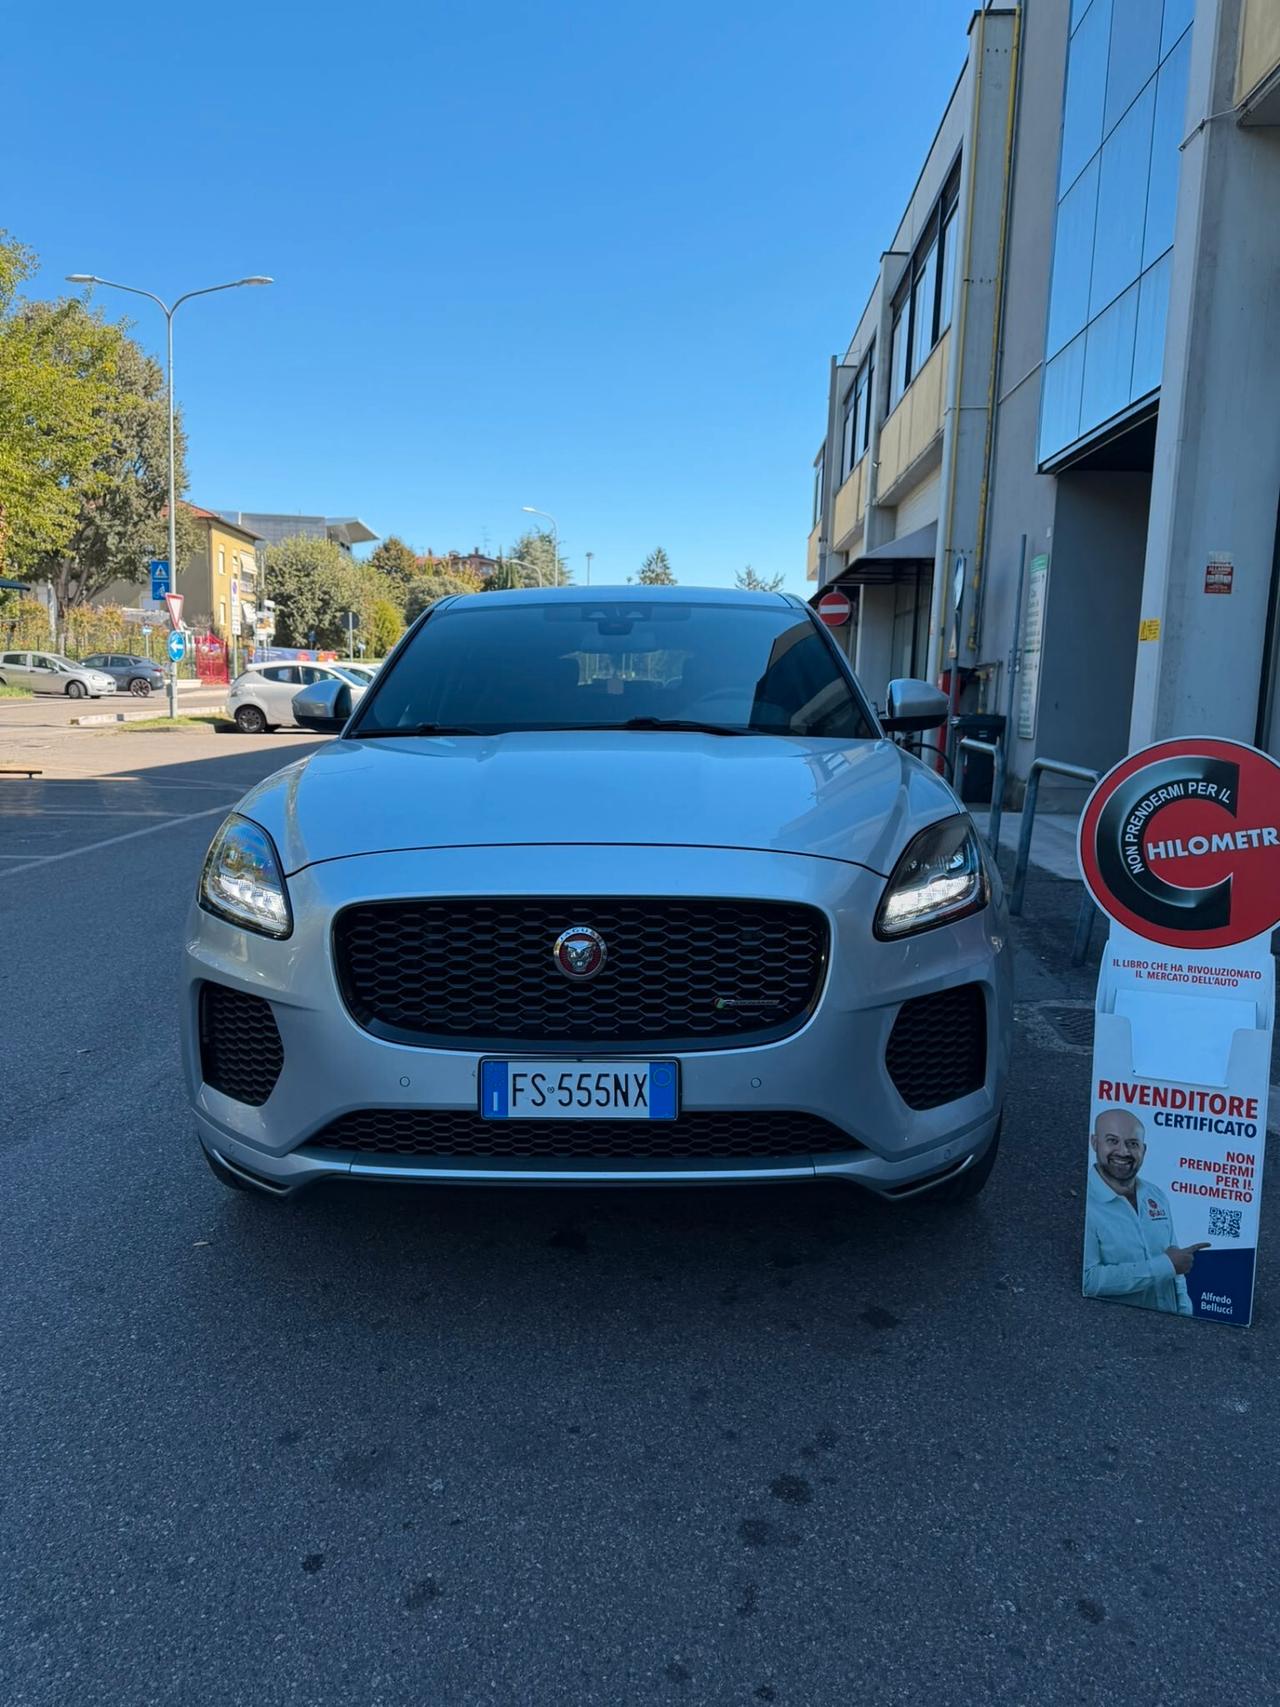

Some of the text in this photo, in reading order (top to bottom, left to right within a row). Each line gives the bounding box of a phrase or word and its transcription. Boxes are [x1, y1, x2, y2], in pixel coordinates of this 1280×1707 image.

[1125, 781, 1231, 875] NON PRENDERMI PER IL
[1112, 959, 1262, 980] IL LIBRO CHE HA RIVOLUZIONATO
[1135, 970, 1239, 987] IL MERCATO DELL'AUTO
[1098, 1080, 1259, 1120] RIVENDITORE
[1153, 1111, 1257, 1138] CERTIFICATO
[1179, 1157, 1254, 1178] PRENDERMI
[1226, 1151, 1255, 1166] NON
[1170, 1180, 1253, 1203] CHILOMETRO
[1215, 1174, 1239, 1189] PER
[1200, 1301, 1233, 1315] Bellucci
[1201, 1291, 1232, 1304] Alfredo
